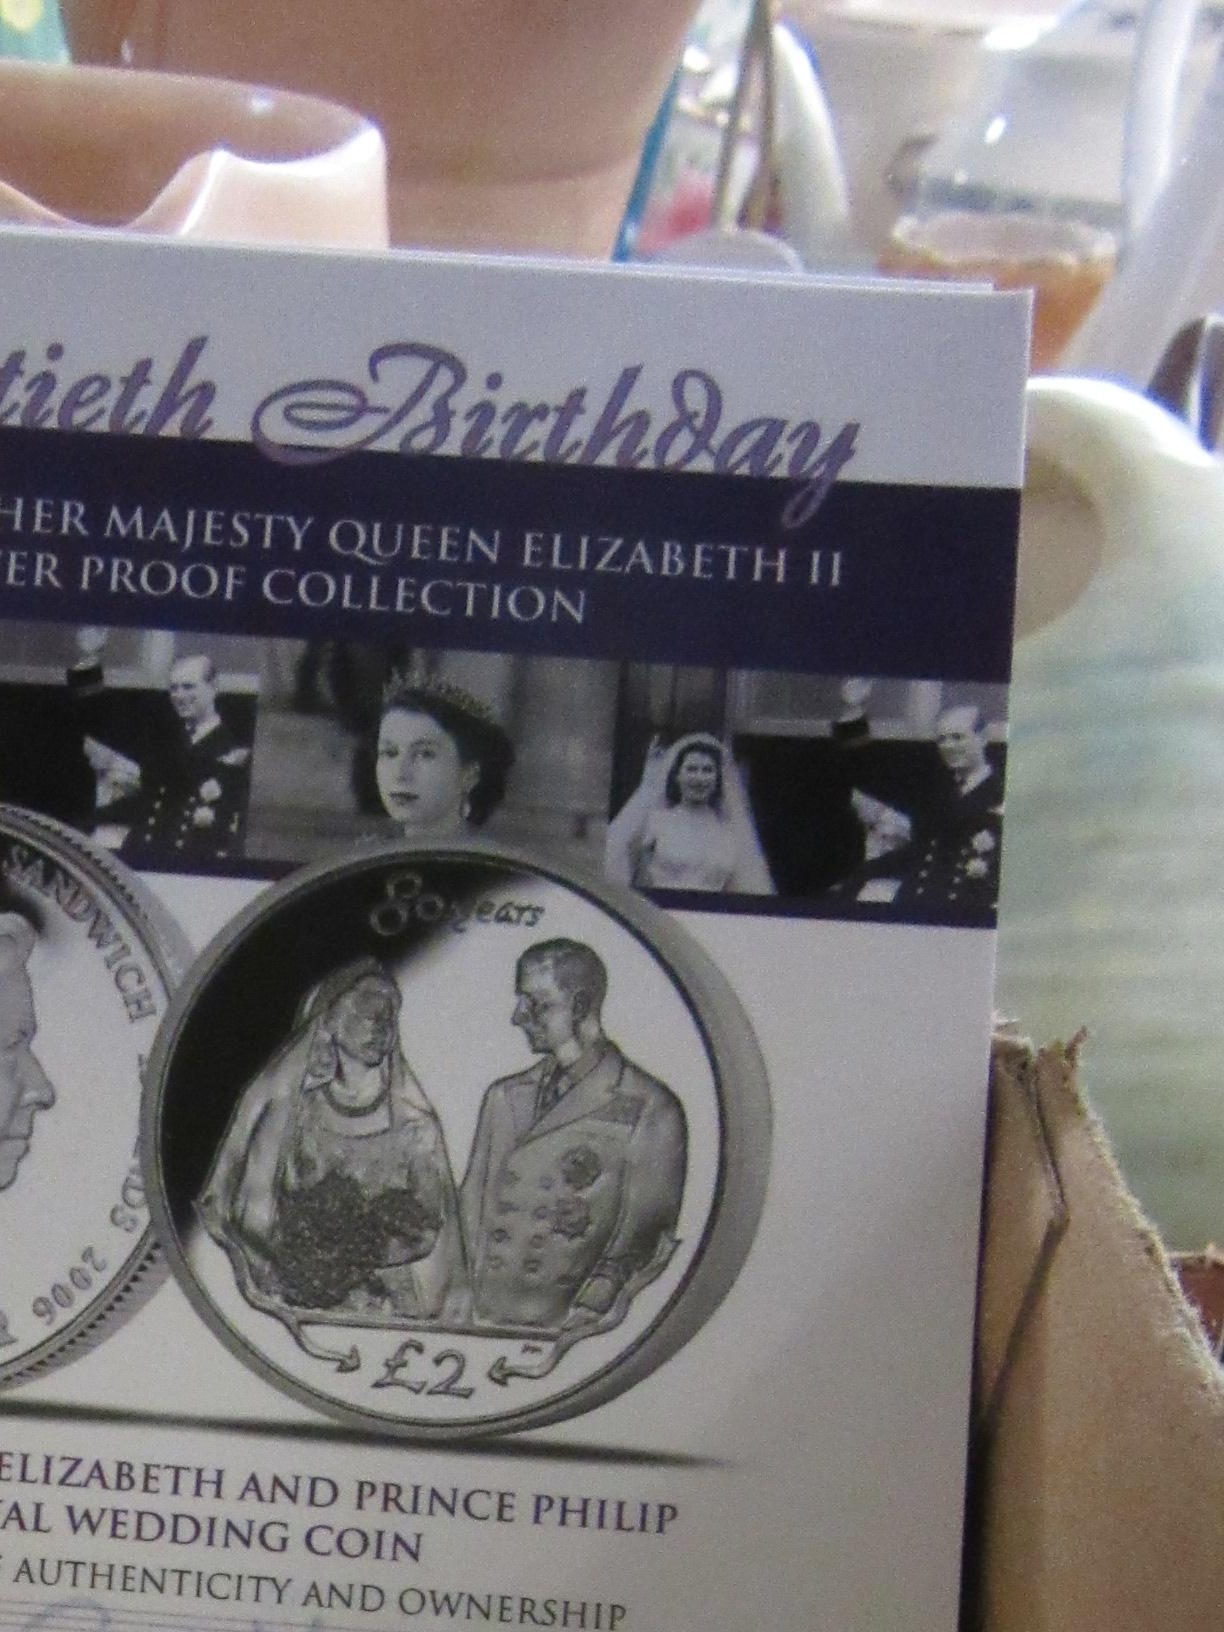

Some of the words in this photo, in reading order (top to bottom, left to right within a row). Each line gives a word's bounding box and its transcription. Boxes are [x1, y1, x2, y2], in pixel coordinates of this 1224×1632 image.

[251, 341, 860, 529] Birthday
[103, 503, 317, 555] MAJESTY
[328, 517, 500, 567] QUEEN
[521, 530, 788, 585] ELIZABETH
[809, 549, 844, 588] II
[78, 551, 249, 600] PROOF
[262, 566, 587, 625] COLLECTION
[2, 845, 157, 1024] SANDWICH
[372, 1341, 474, 1399] £2
[67, 1506, 290, 1554] WEDDING
[305, 1523, 423, 1563] COIN
[239, 1472, 339, 1509] AND
[355, 1480, 515, 1524] PRINCE
[533, 1493, 678, 1535] PHILIP
[14, 1559, 291, 1604] AUTHENTICITY
[302, 1581, 385, 1613] AND
[399, 1589, 626, 1632] OWNERSHIP
